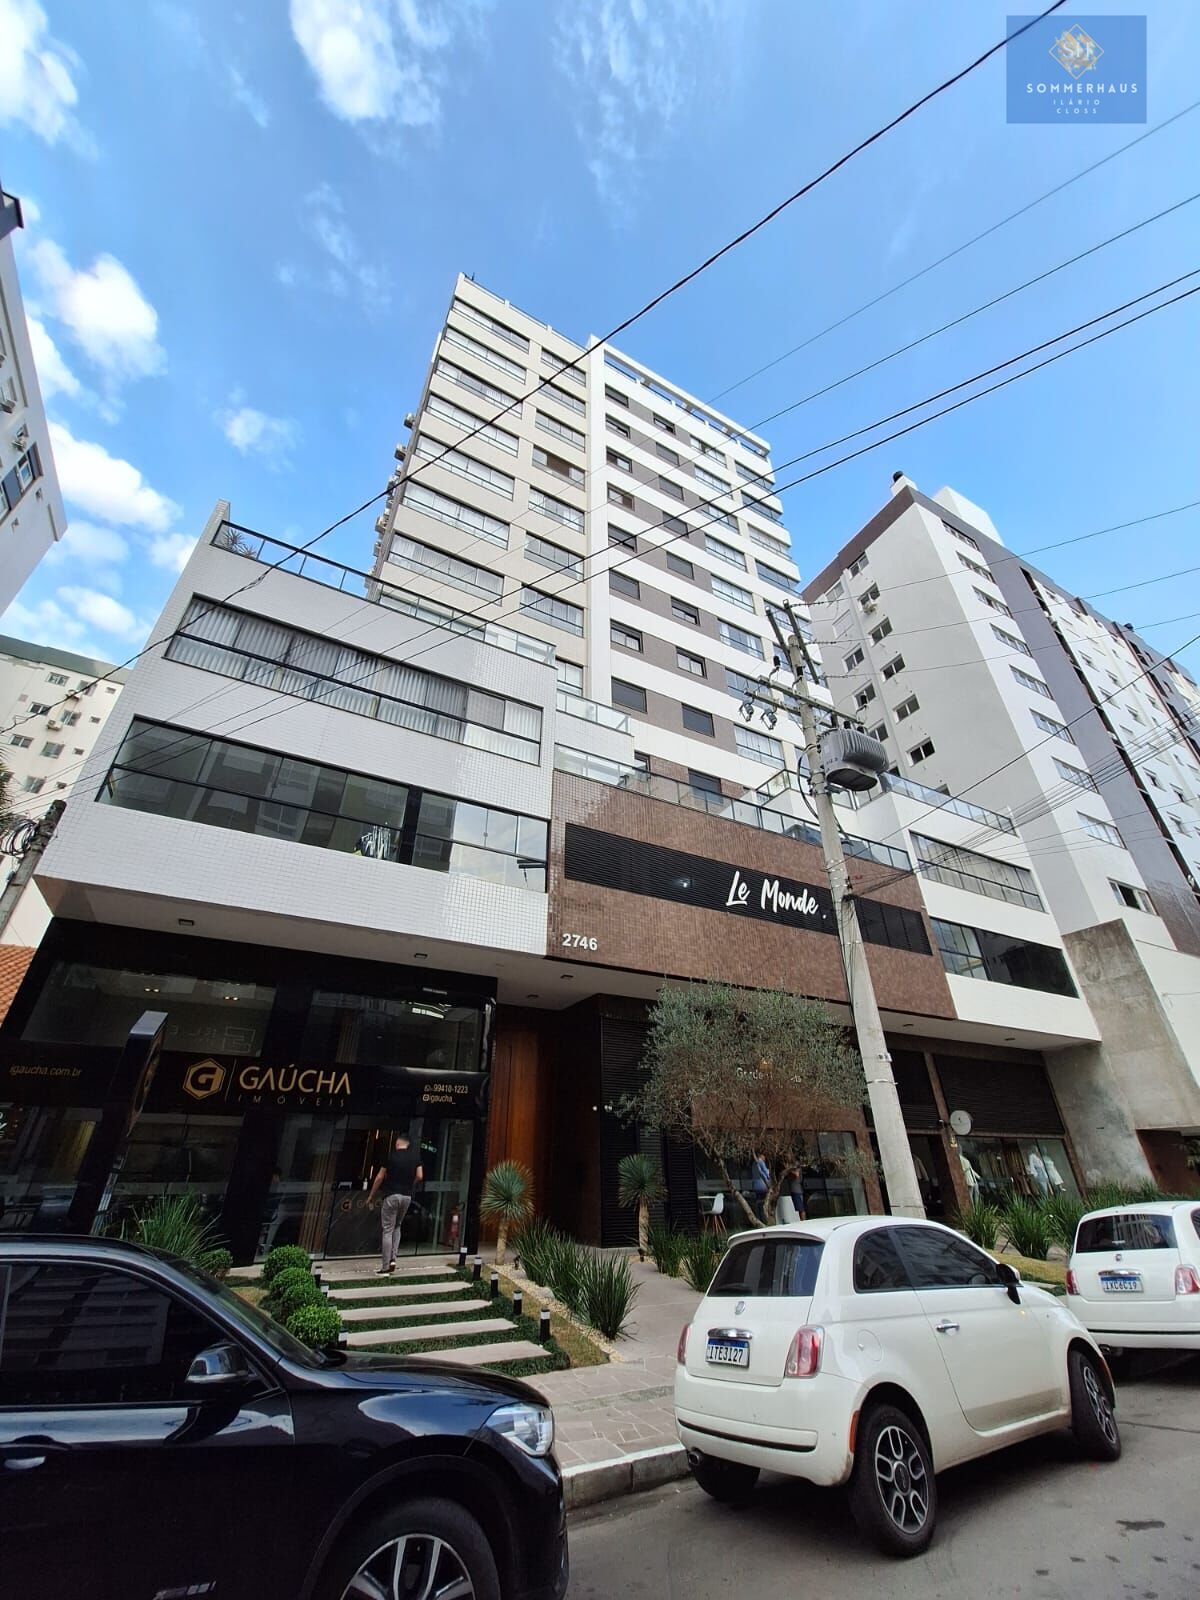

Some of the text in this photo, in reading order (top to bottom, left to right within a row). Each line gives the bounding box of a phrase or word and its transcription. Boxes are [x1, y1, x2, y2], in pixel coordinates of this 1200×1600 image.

[725, 870, 750, 906] Le
[562, 933, 598, 951] 2746
[239, 1063, 351, 1095] GAÚCHA
[238, 1093, 345, 1108] IMÓVEIS
